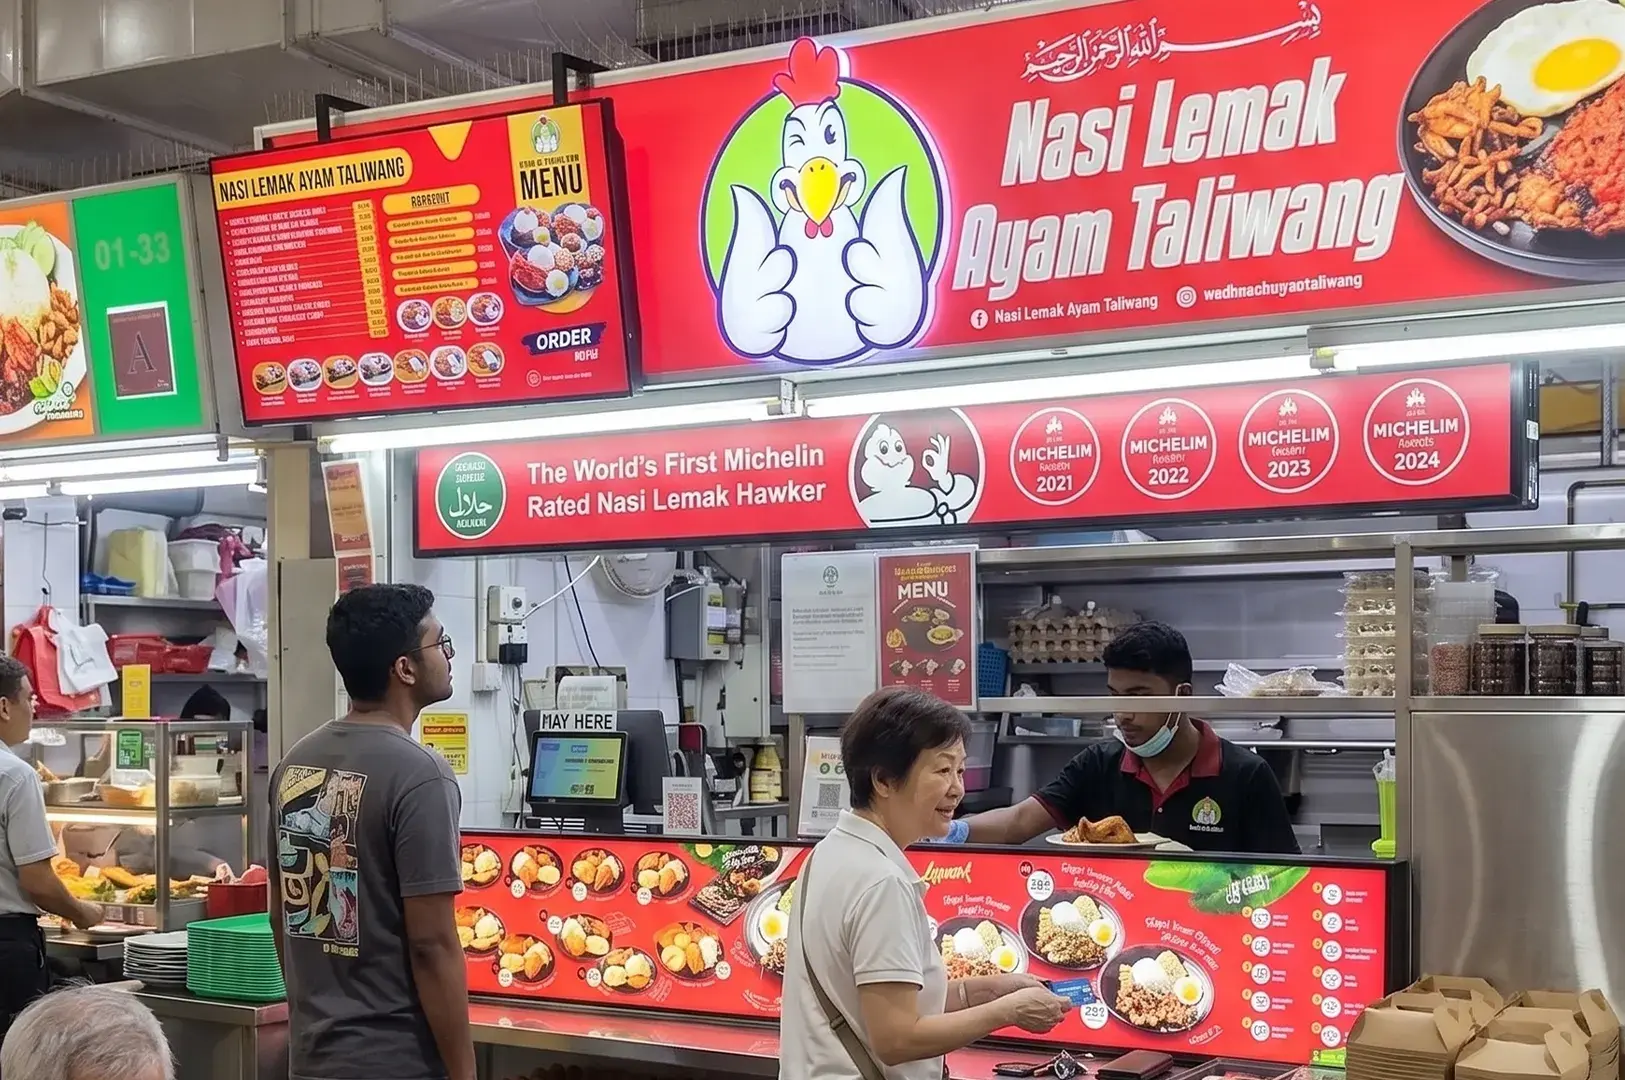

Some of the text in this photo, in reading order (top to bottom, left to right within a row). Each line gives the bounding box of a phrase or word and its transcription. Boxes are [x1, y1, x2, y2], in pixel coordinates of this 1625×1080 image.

[1000, 56, 1348, 187] Nasi Lemak
[219, 156, 406, 202] NASI LEMAK AYAM TALIWANG
[520, 163, 583, 200] MENU
[94, 231, 171, 271] 01-33
[951, 172, 1407, 302] Ayam Taliwang
[995, 295, 1159, 324] Nasi Lemak Ayam Taliwang
[127, 331, 158, 374] A
[536, 327, 592, 351] ORDER
[528, 442, 824, 485] The World's First Michelin
[1148, 466, 1189, 486] 2022
[1267, 459, 1312, 479] 2023
[1393, 451, 1441, 471] 2024
[528, 480, 827, 519] Rated Nasi Lemak Hawker
[1036, 475, 1074, 493] 2021
[897, 581, 948, 600] MENU
[542, 713, 613, 729] MAY HERE
